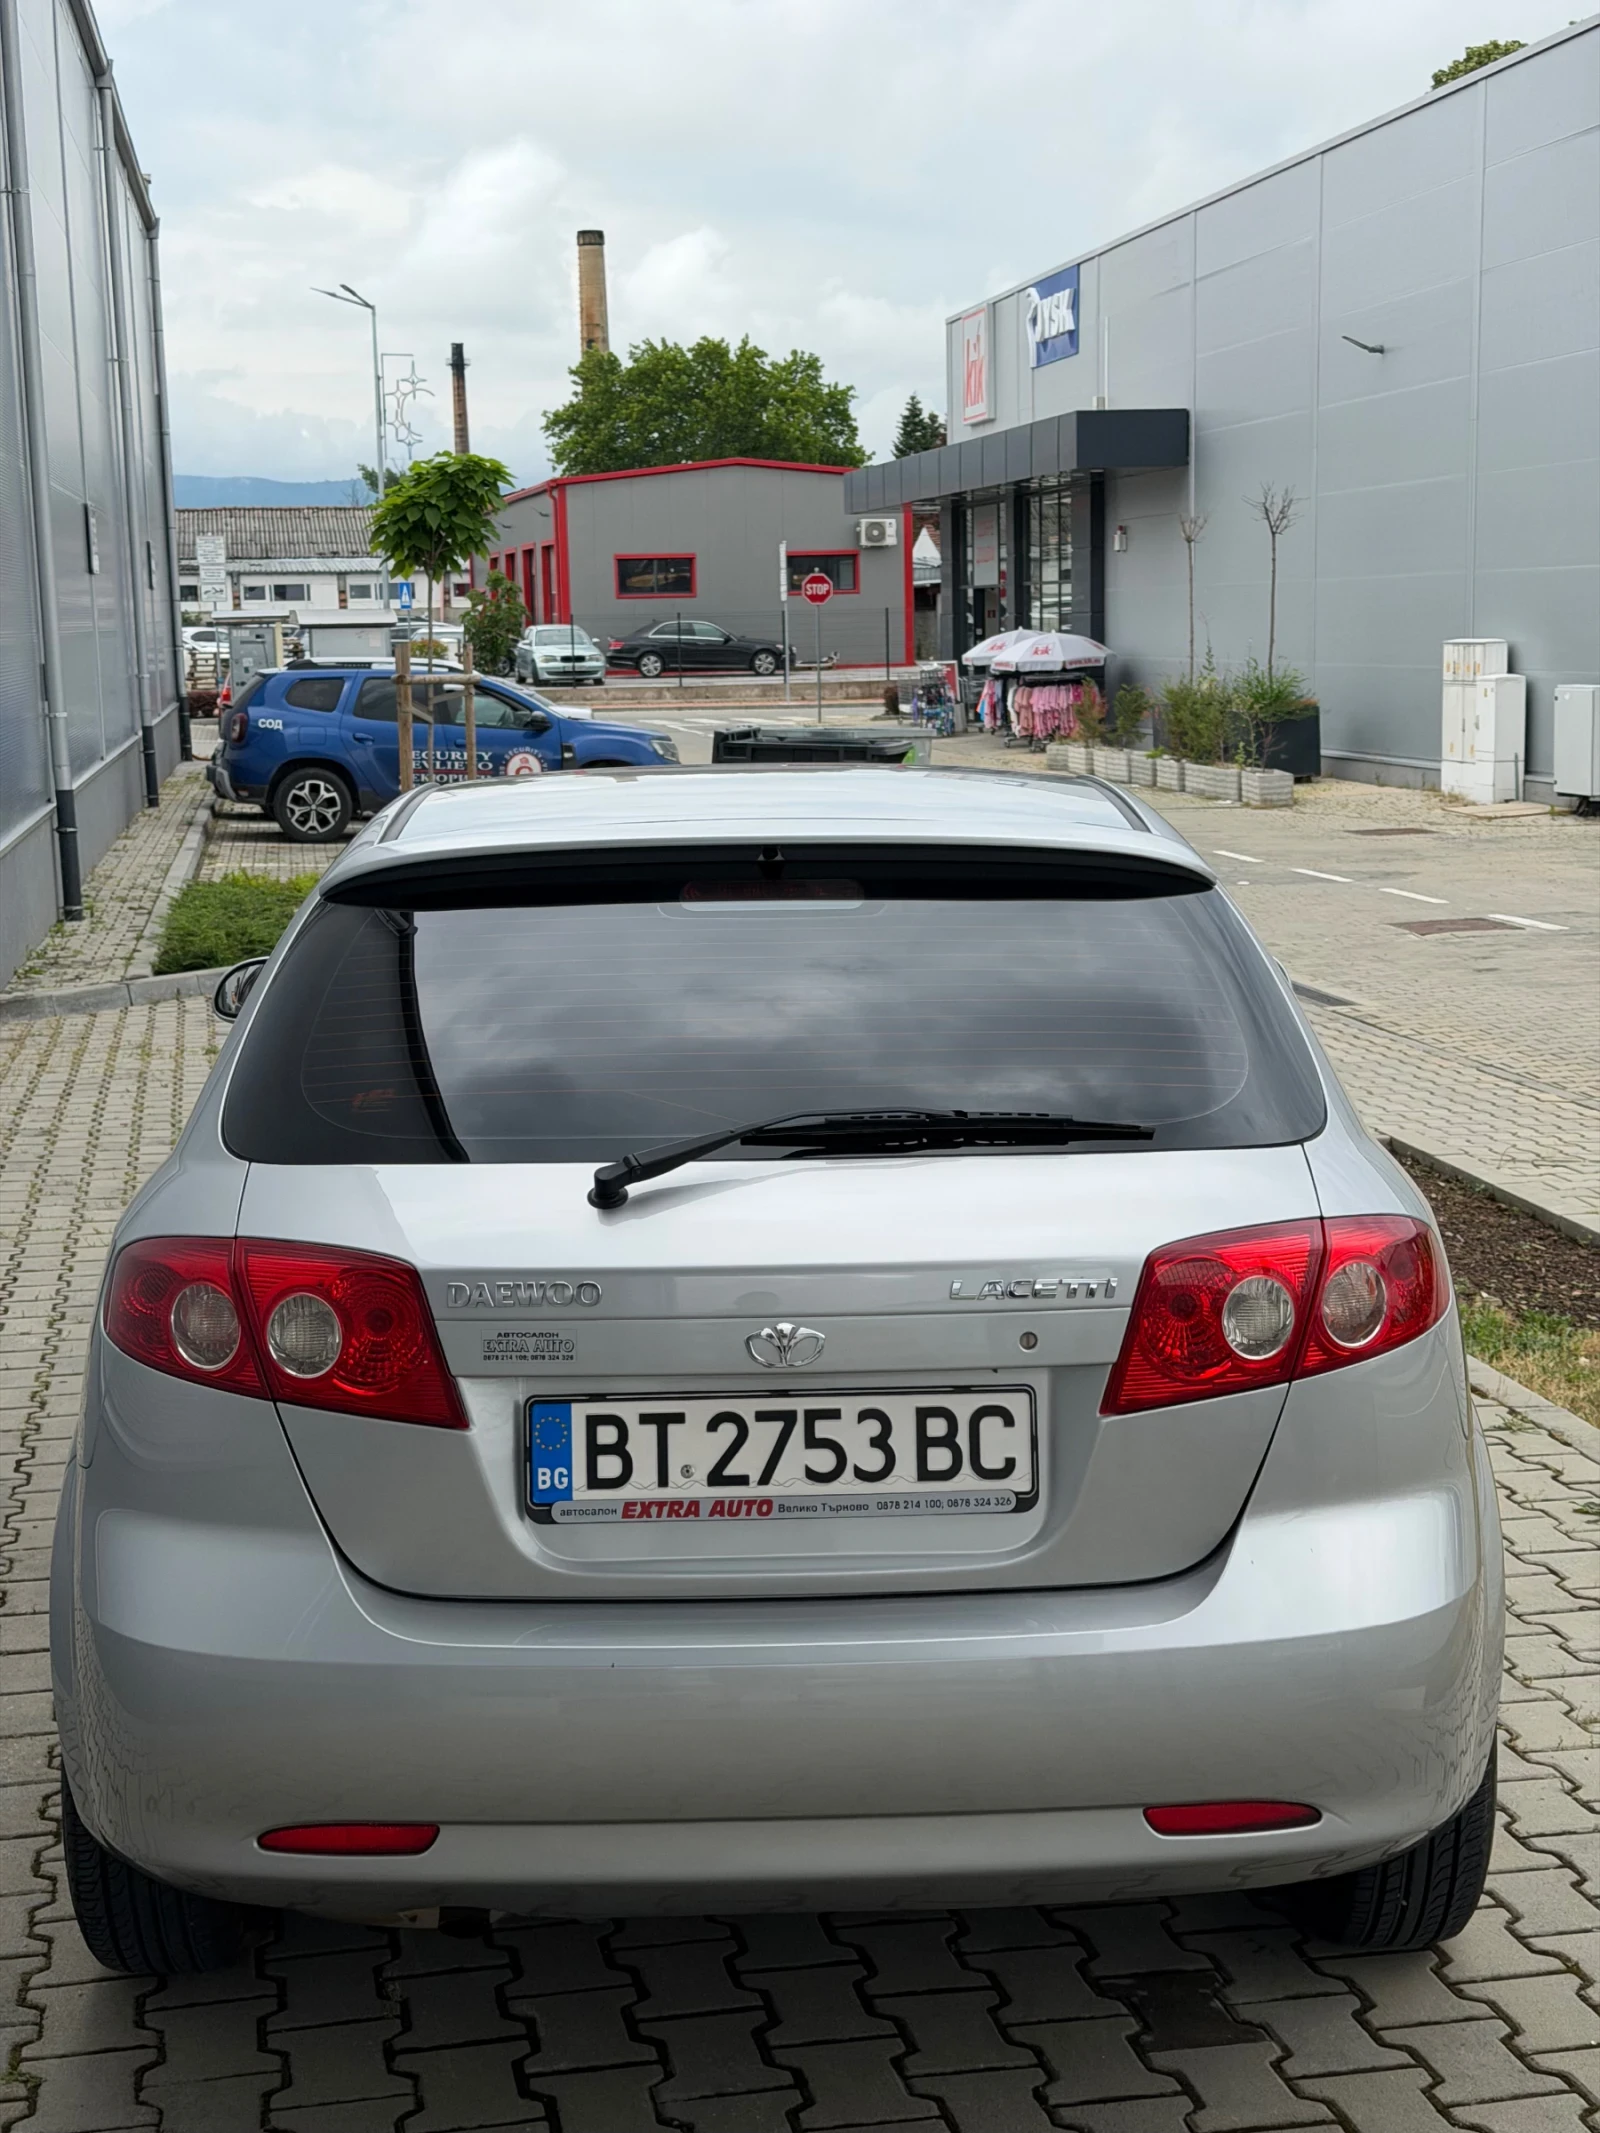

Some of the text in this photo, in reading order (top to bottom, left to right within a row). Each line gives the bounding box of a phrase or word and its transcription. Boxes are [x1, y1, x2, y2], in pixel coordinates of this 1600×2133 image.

[1035, 288, 1076, 342] JYSK
[805, 583, 830, 595] STOP
[258, 718, 284, 731] СОД
[446, 1281, 602, 1308] DAEWOO
[950, 1277, 1119, 1301] LACETTI
[483, 1339, 575, 1353] EXTRA AUTO
[585, 1404, 1016, 1490] BT 2753 BC
[537, 1467, 569, 1490] BG
[559, 1507, 618, 1518] автосалон
[620, 1501, 701, 1520] EXTRA
[707, 1499, 774, 1518] AUTO
[777, 1502, 819, 1514] Велико
[820, 1500, 870, 1513] Търново
[876, 1500, 901, 1511] 0878
[902, 1499, 922, 1509] 214
[946, 1497, 971, 1508] 0878
[973, 1496, 992, 1507] 324
[993, 1495, 1013, 1506] 326
